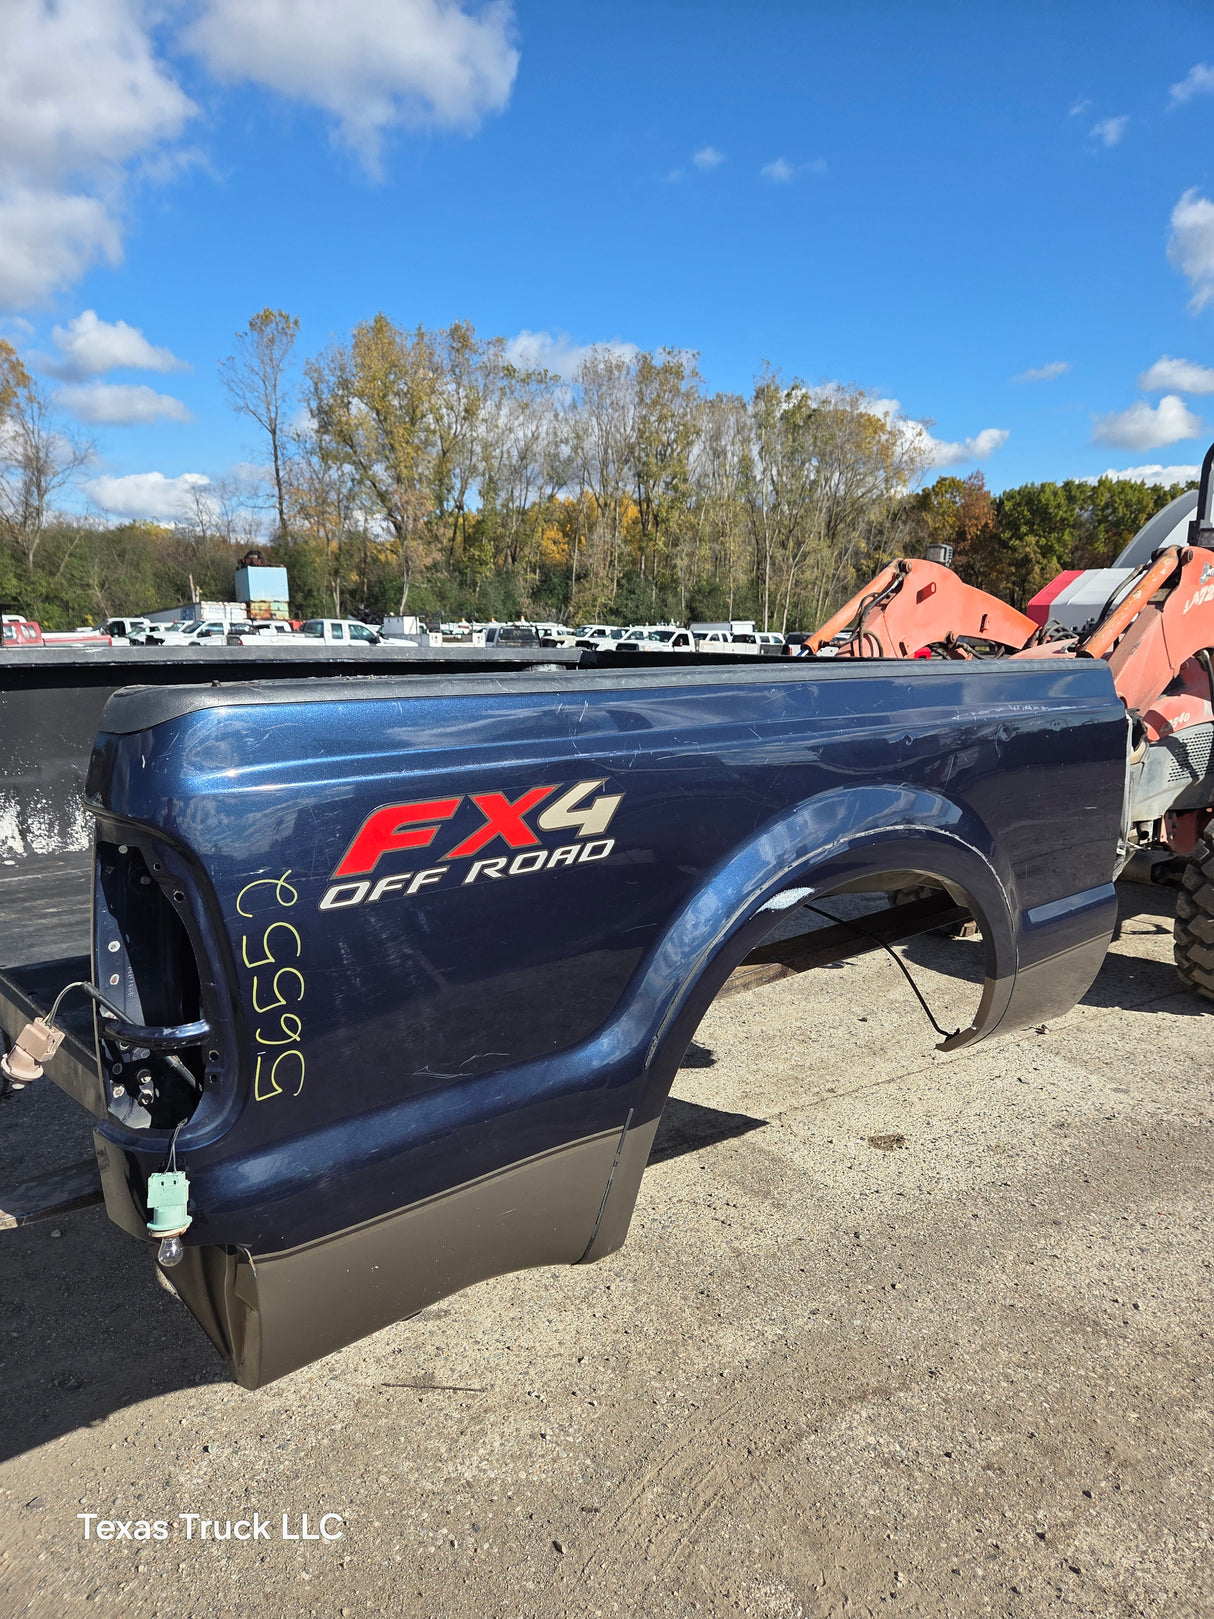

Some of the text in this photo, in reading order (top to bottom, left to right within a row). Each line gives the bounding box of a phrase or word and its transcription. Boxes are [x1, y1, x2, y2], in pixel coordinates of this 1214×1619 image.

[318, 837, 616, 911] OFF ROAD
[330, 778, 626, 880] FX4
[236, 869, 306, 1101] 56552
